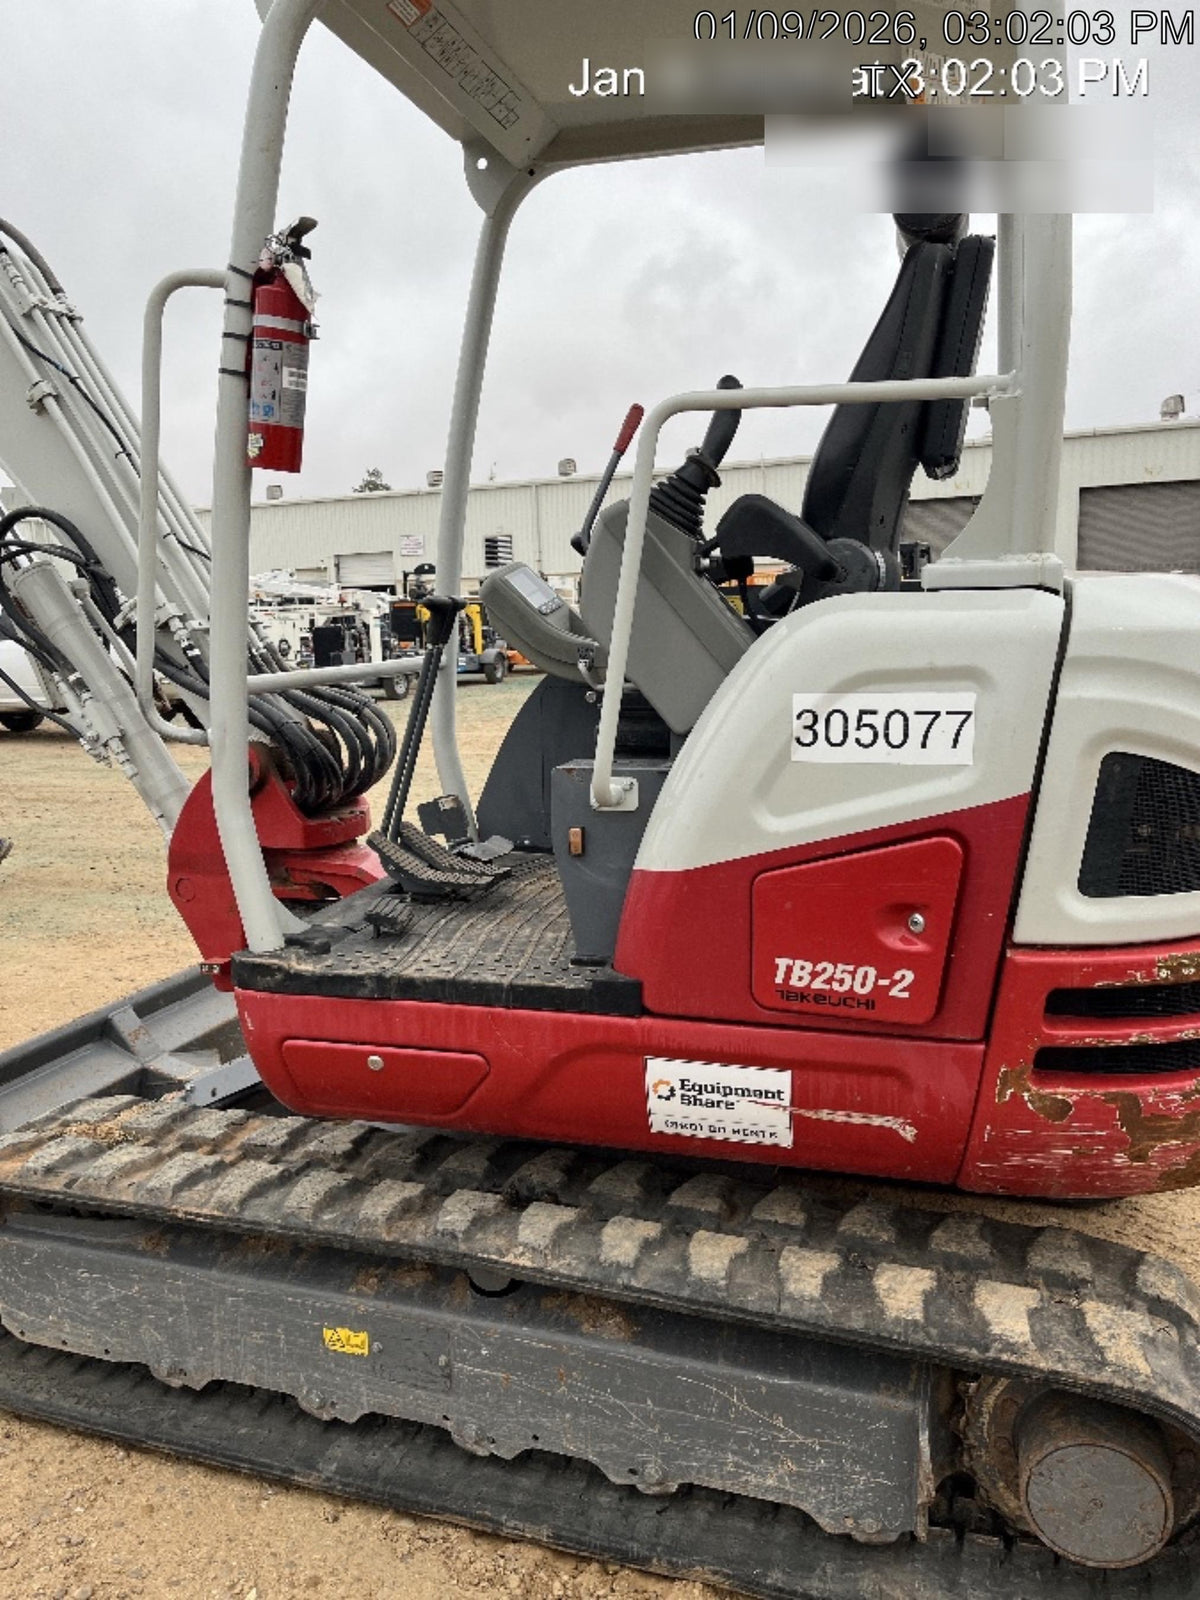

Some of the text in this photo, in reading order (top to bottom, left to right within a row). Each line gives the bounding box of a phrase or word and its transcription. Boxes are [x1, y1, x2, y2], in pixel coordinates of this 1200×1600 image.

[794, 708, 974, 749] 305077
[774, 957, 915, 998] TB250-2
[678, 1078, 786, 1101] Equipment
[680, 1093, 736, 1110] Share
